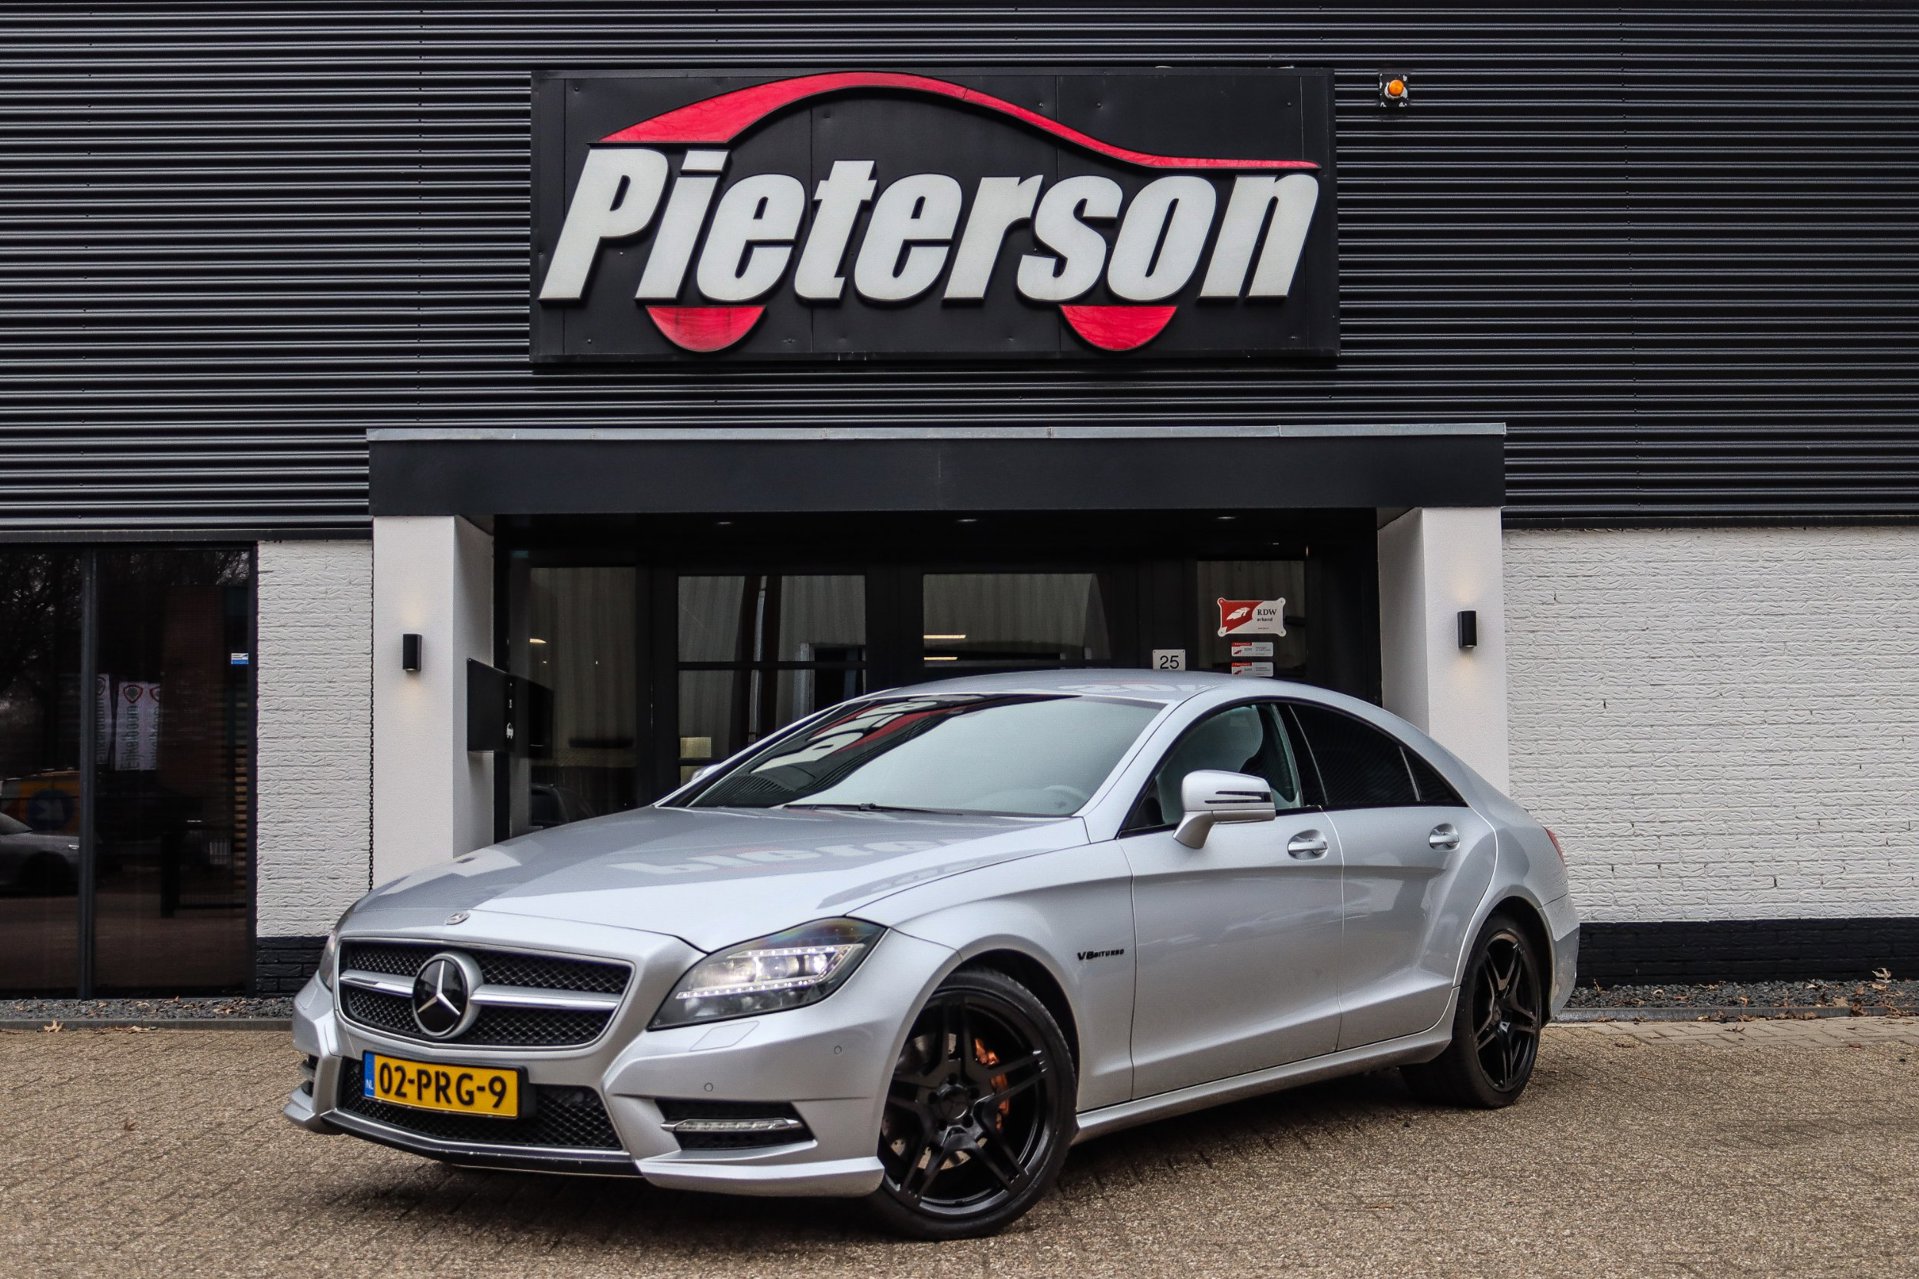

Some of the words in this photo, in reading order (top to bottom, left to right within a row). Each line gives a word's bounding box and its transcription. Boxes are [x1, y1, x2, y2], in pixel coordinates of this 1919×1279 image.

[538, 147, 1320, 303] Pieterson
[1257, 608, 1277, 616] RDW
[1160, 655, 1180, 669] 25
[365, 1079, 374, 1090] NL
[379, 1062, 507, 1109] 02-PRG-9
